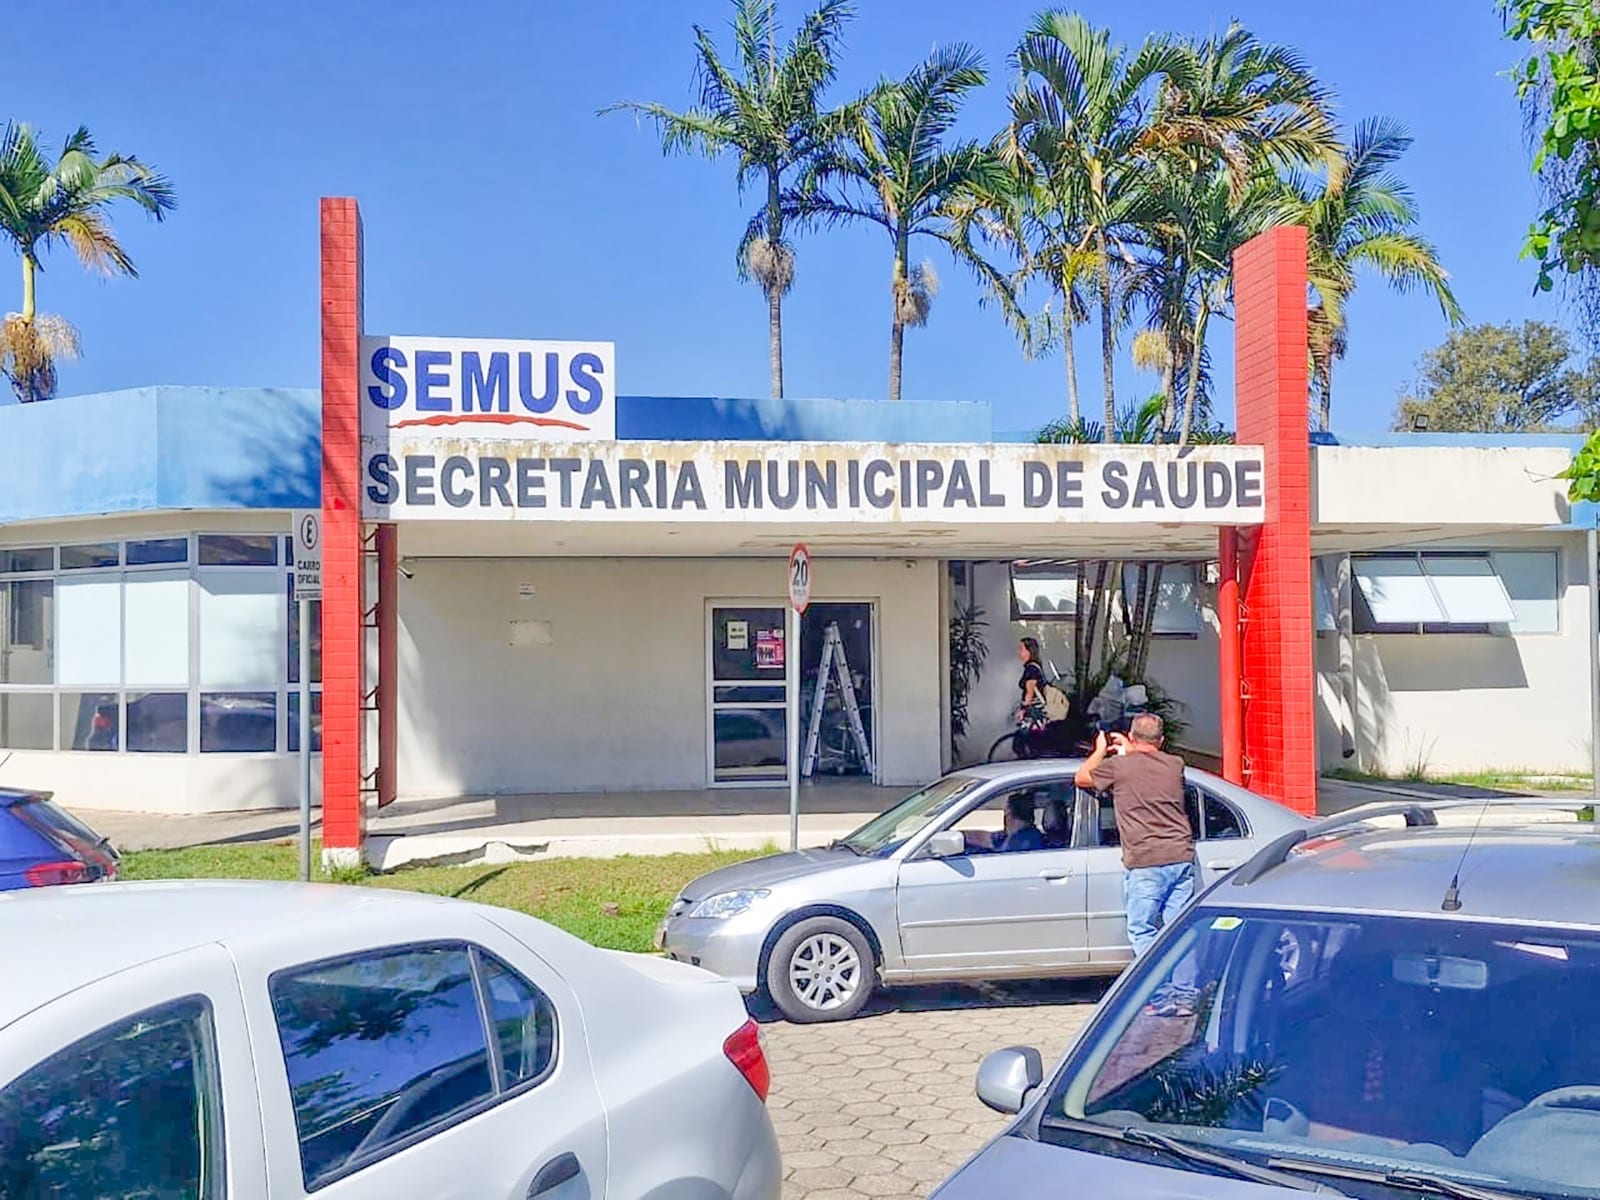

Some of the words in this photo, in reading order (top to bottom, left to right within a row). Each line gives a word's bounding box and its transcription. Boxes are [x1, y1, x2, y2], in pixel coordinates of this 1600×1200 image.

[368, 347, 604, 415] SEMUS
[367, 454, 707, 509] SECRETARIA
[724, 459, 1005, 509] MUNICIPAL
[1023, 461, 1083, 508] DE
[1101, 446, 1262, 509] SAÚDE
[306, 519, 313, 544] E
[297, 560, 321, 571] CARRO
[792, 558, 808, 587] 20
[297, 574, 321, 585] OFICIAL
